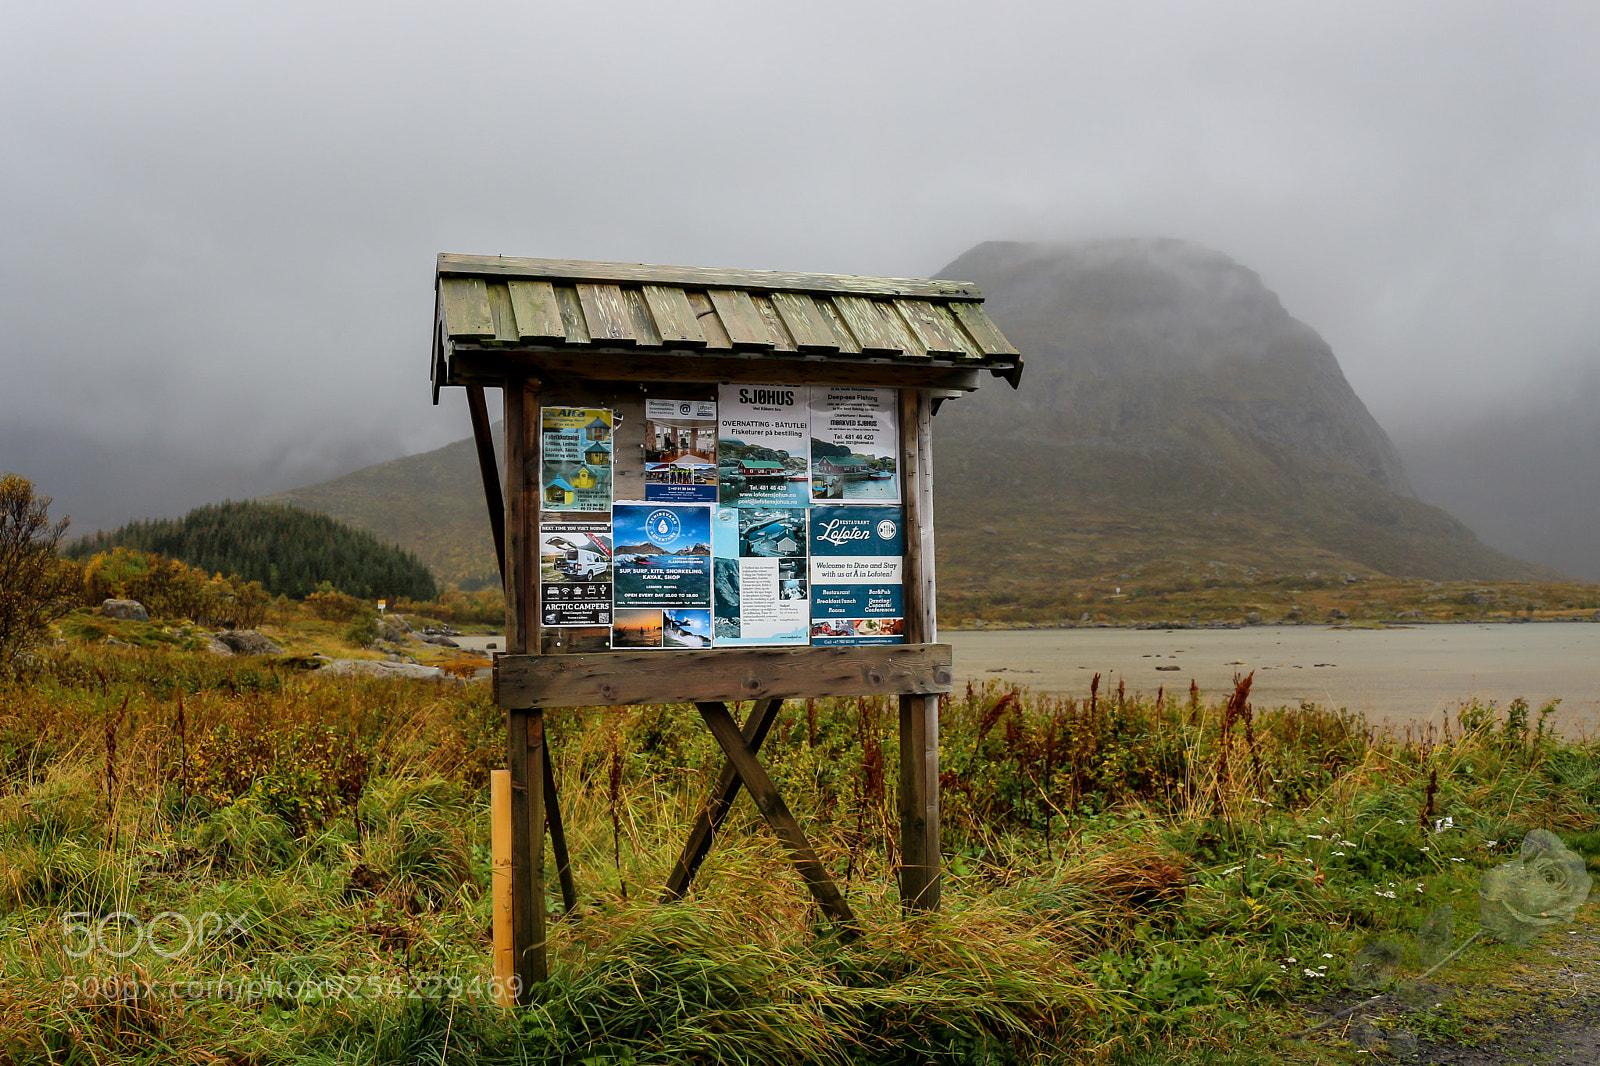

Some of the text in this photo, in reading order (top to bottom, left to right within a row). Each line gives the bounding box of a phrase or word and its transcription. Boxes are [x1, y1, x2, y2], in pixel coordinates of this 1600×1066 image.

[740, 389, 794, 405] SJØHUS
[816, 519, 870, 546] Lofoten
[884, 562, 897, 570] Stay
